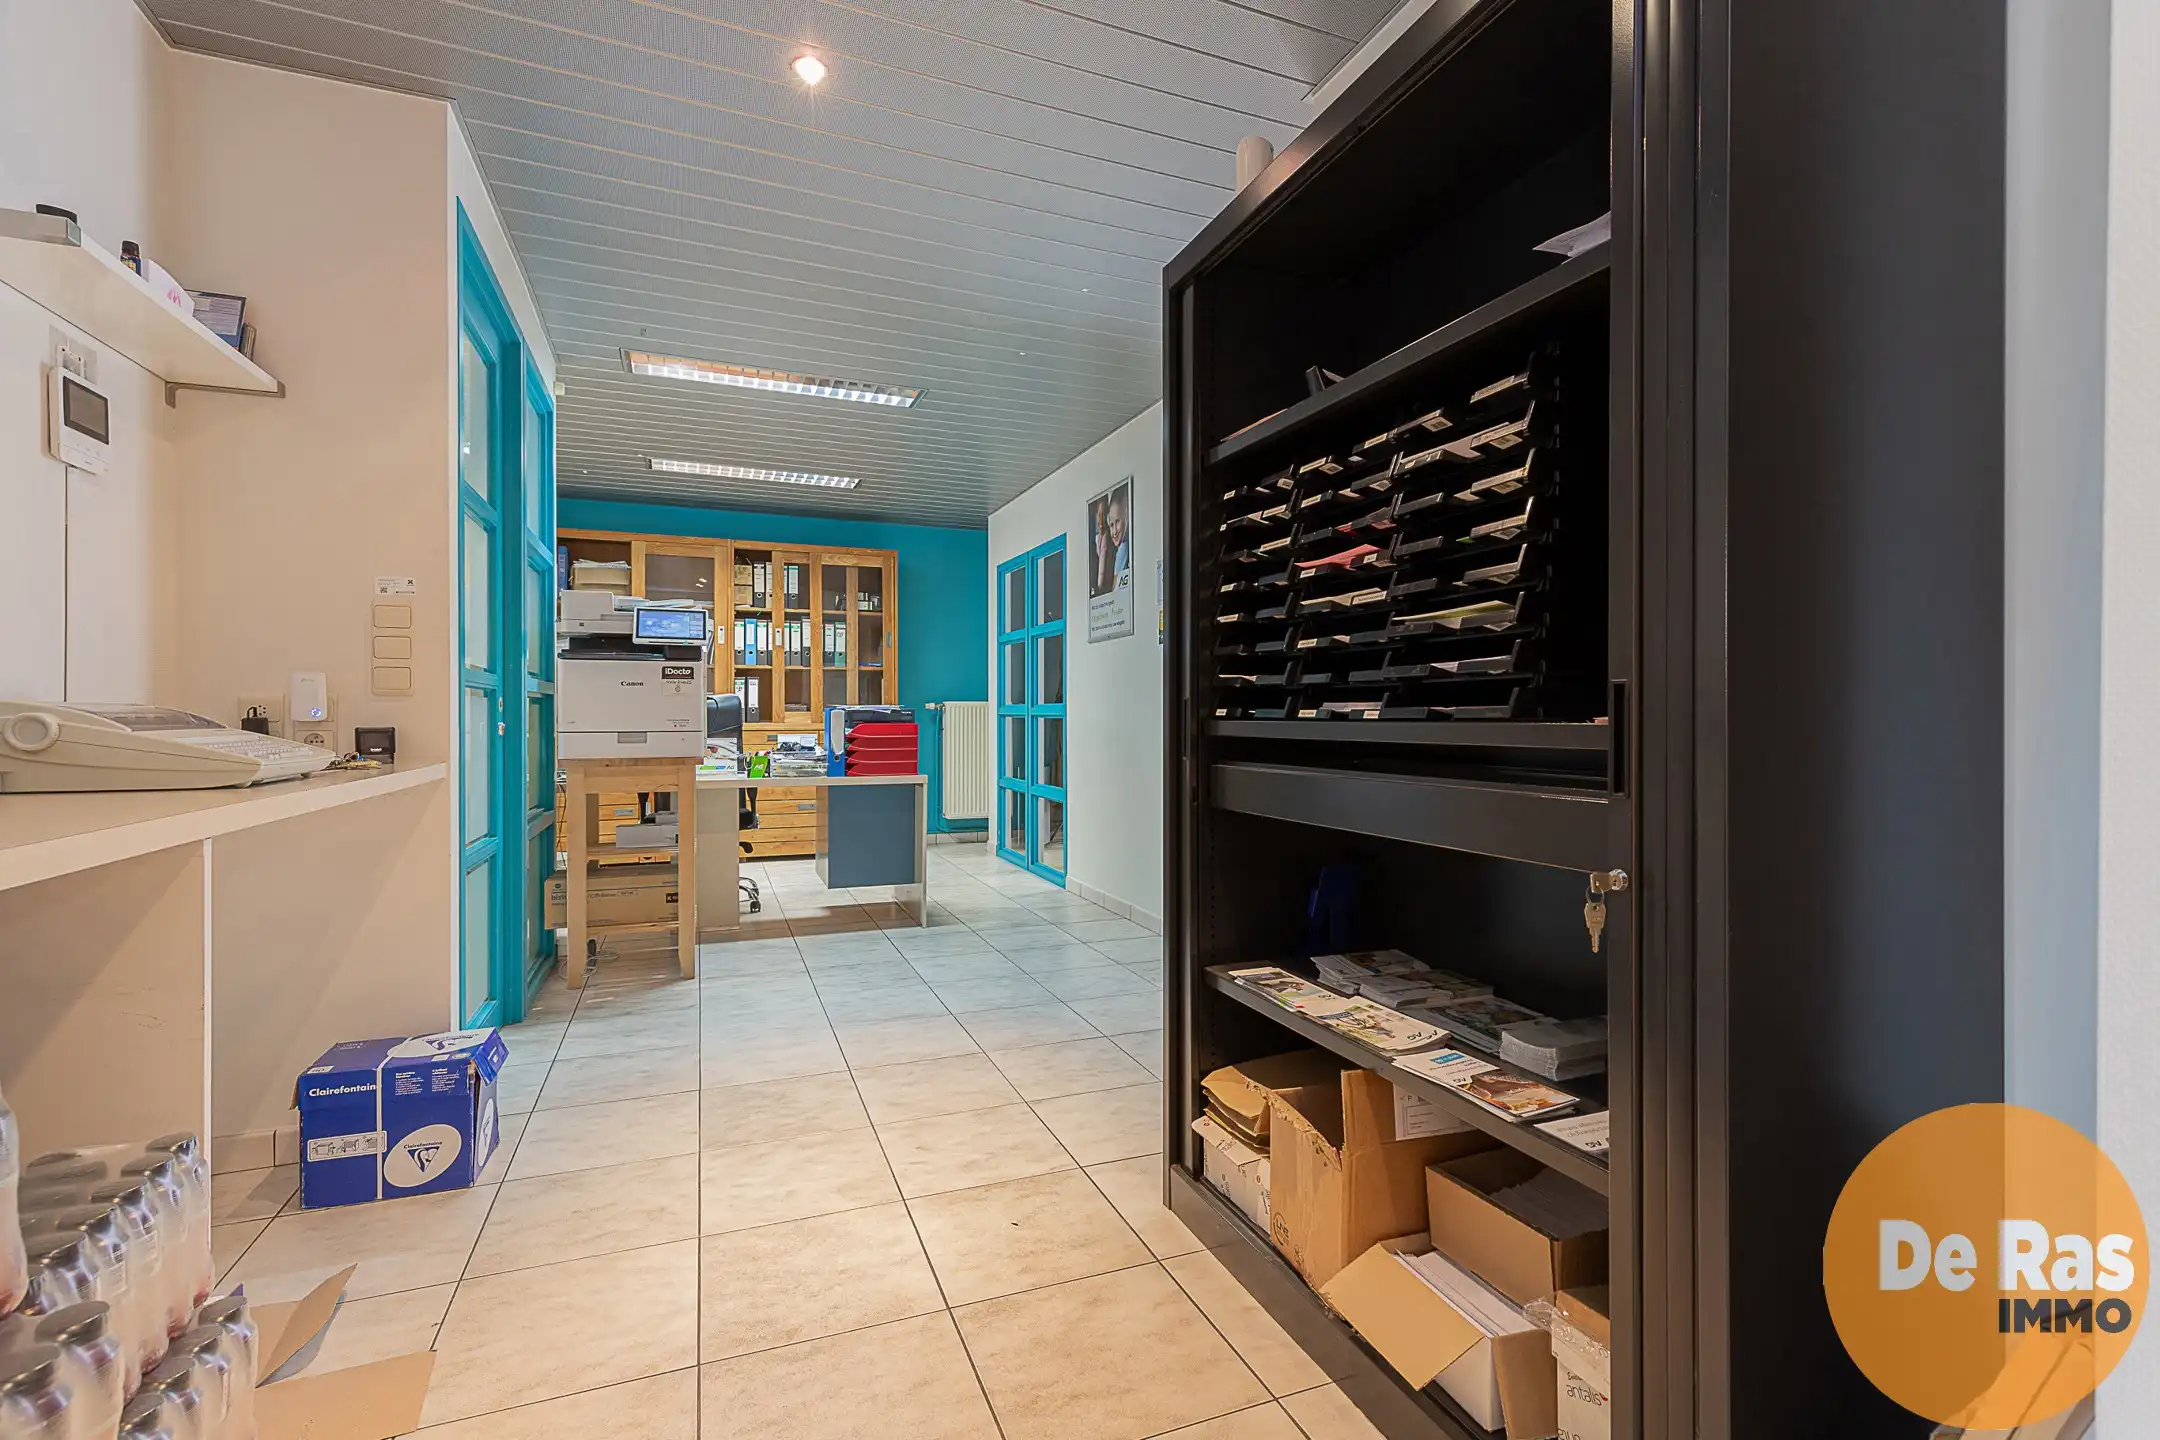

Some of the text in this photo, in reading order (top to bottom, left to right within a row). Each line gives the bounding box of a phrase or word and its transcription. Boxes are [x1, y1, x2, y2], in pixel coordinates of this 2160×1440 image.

[308, 1082, 377, 1097] Clairefontain
[403, 1140, 443, 1149] Clairefontaine
[1566, 1384, 1602, 1405] antalis
